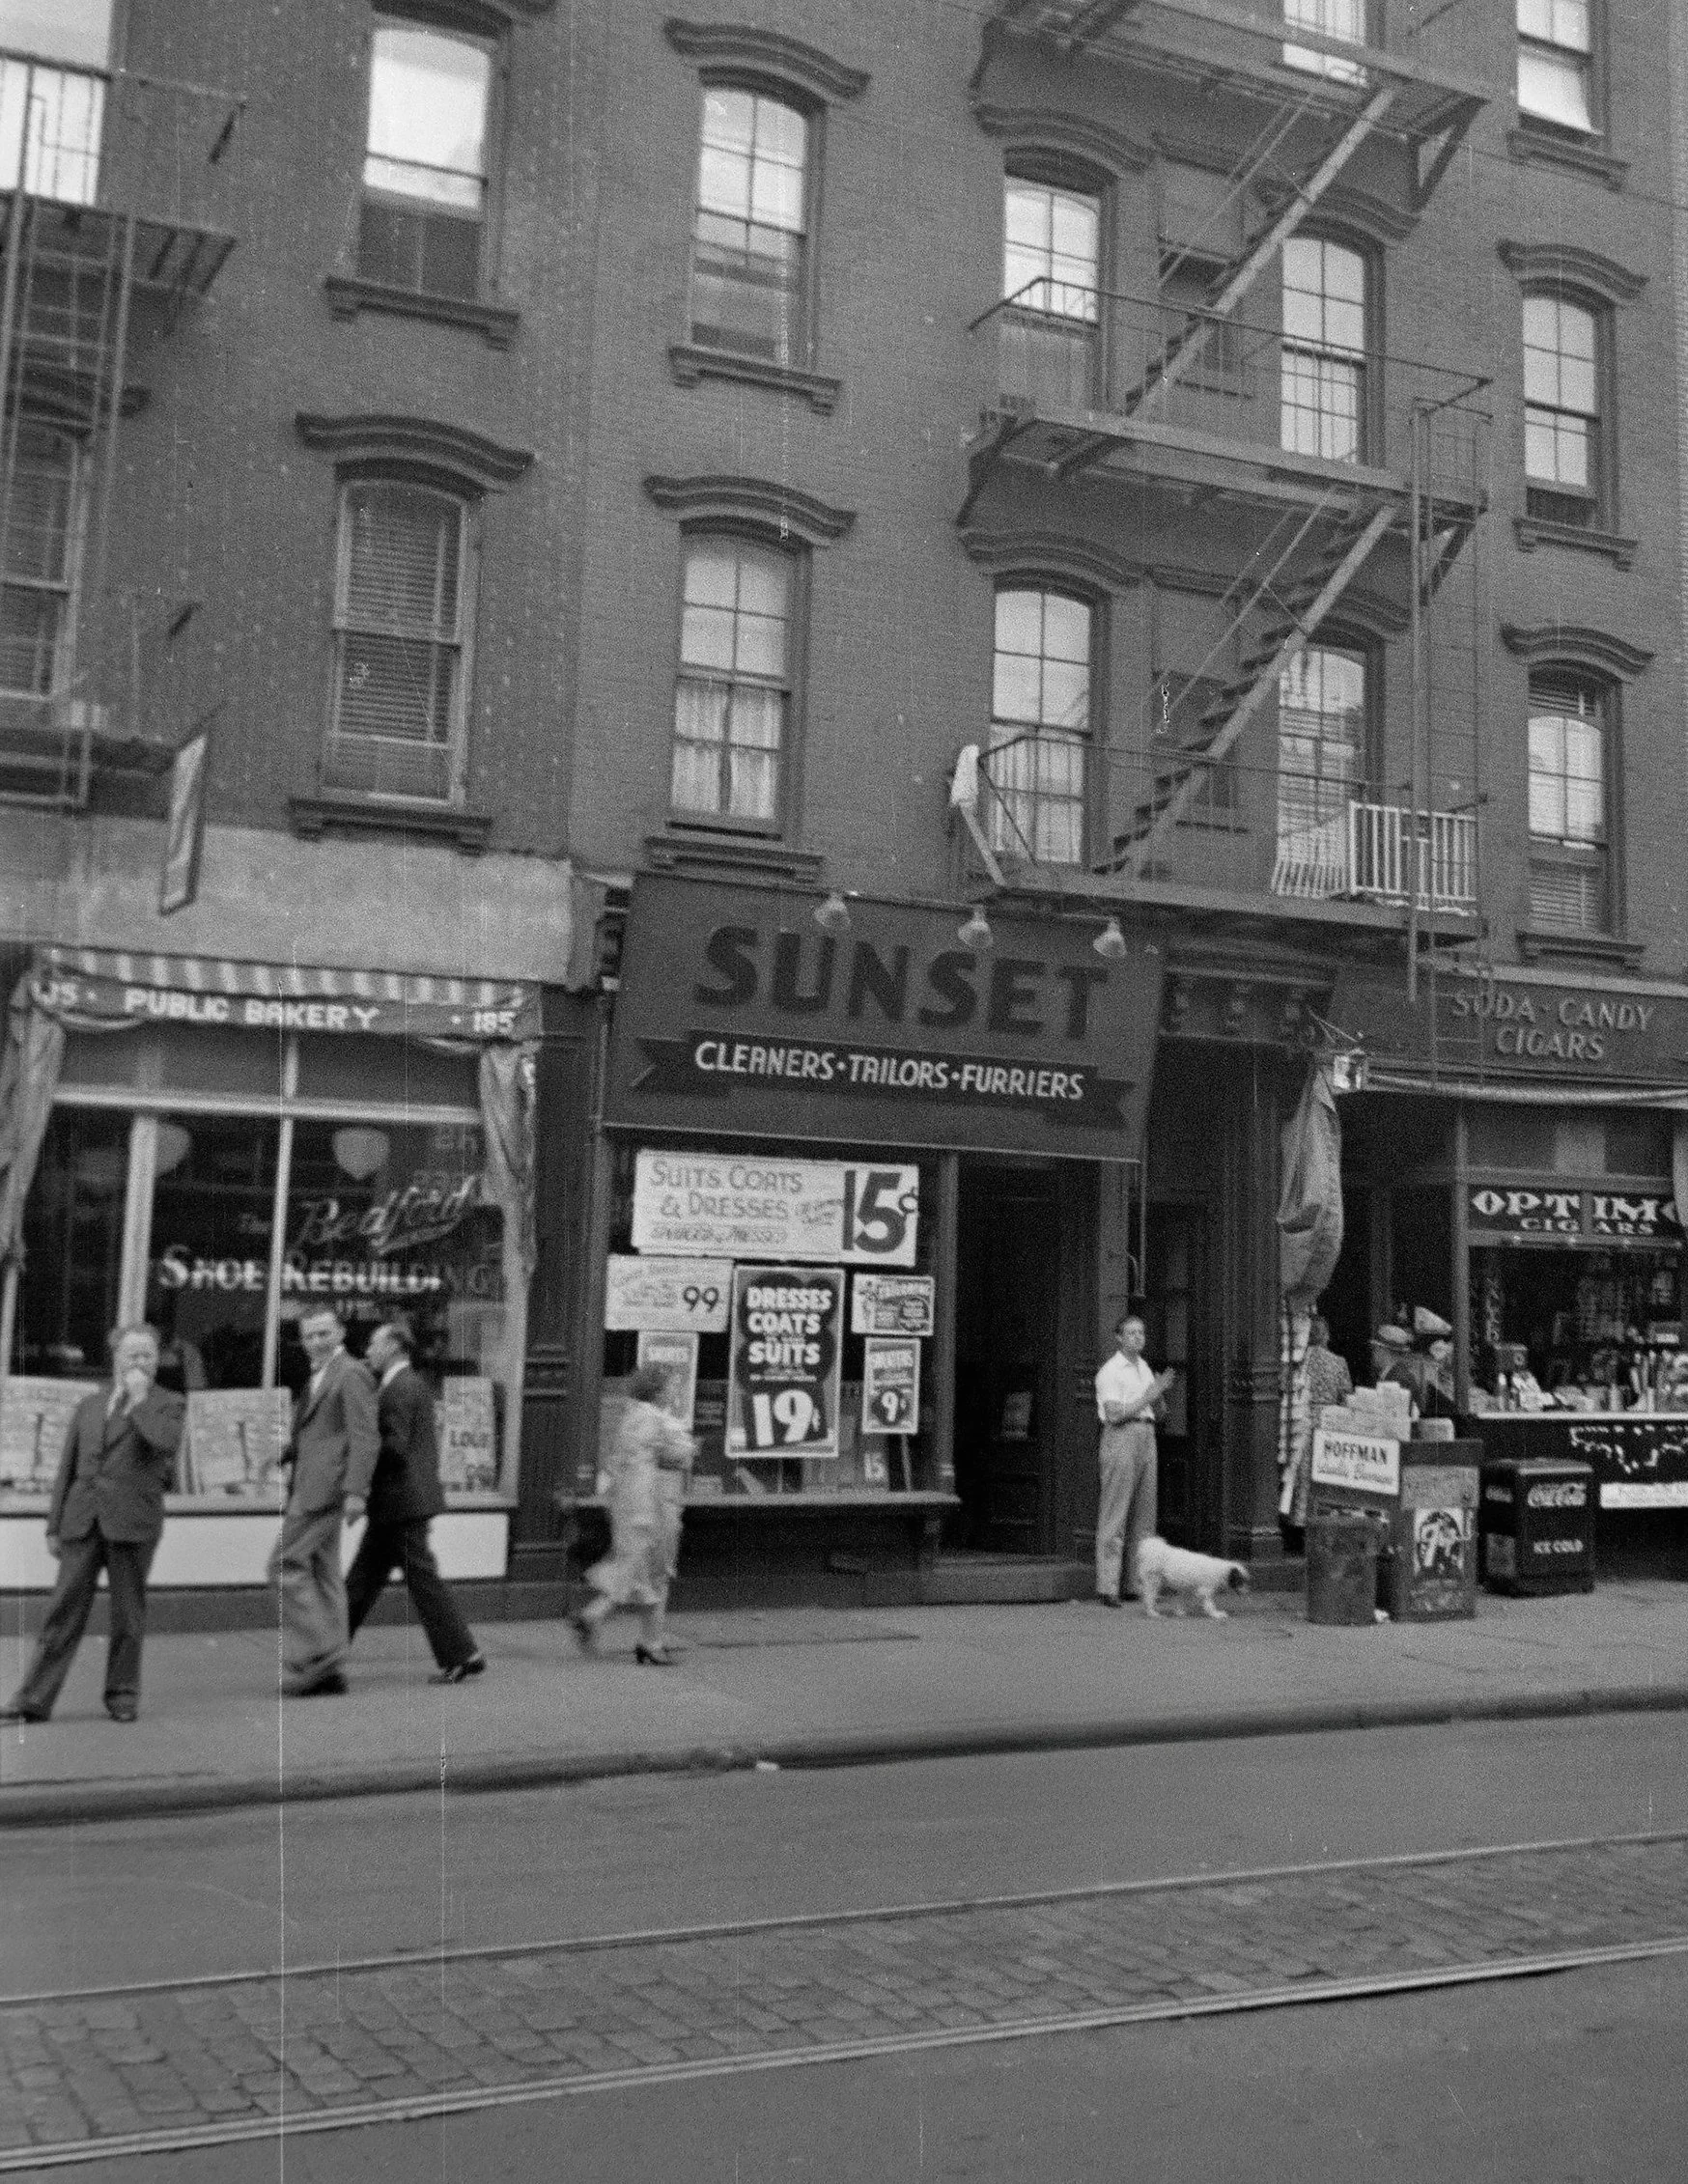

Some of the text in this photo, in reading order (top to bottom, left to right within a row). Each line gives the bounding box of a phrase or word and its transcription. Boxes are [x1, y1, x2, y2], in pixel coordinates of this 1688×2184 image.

[694, 927, 1109, 1040] SUNSET
[124, 988, 230, 1022] PUBLIC
[244, 998, 380, 1030] BAKERY
[1451, 988, 1655, 1031] SODA CANDY
[1496, 1025, 1605, 1061] CIGARS
[694, 1040, 1083, 1101] CLEANERS TAILORS FURRIERS
[649, 1159, 803, 1194] SUITS COATS
[688, 1190, 790, 1220] DRESSES
[1520, 1217, 1654, 1236] CIGARS
[157, 1243, 265, 1291] SHOE
[747, 1286, 832, 1311] DRESSES
[747, 1311, 821, 1334] COATS
[748, 1341, 821, 1366] SUITS
